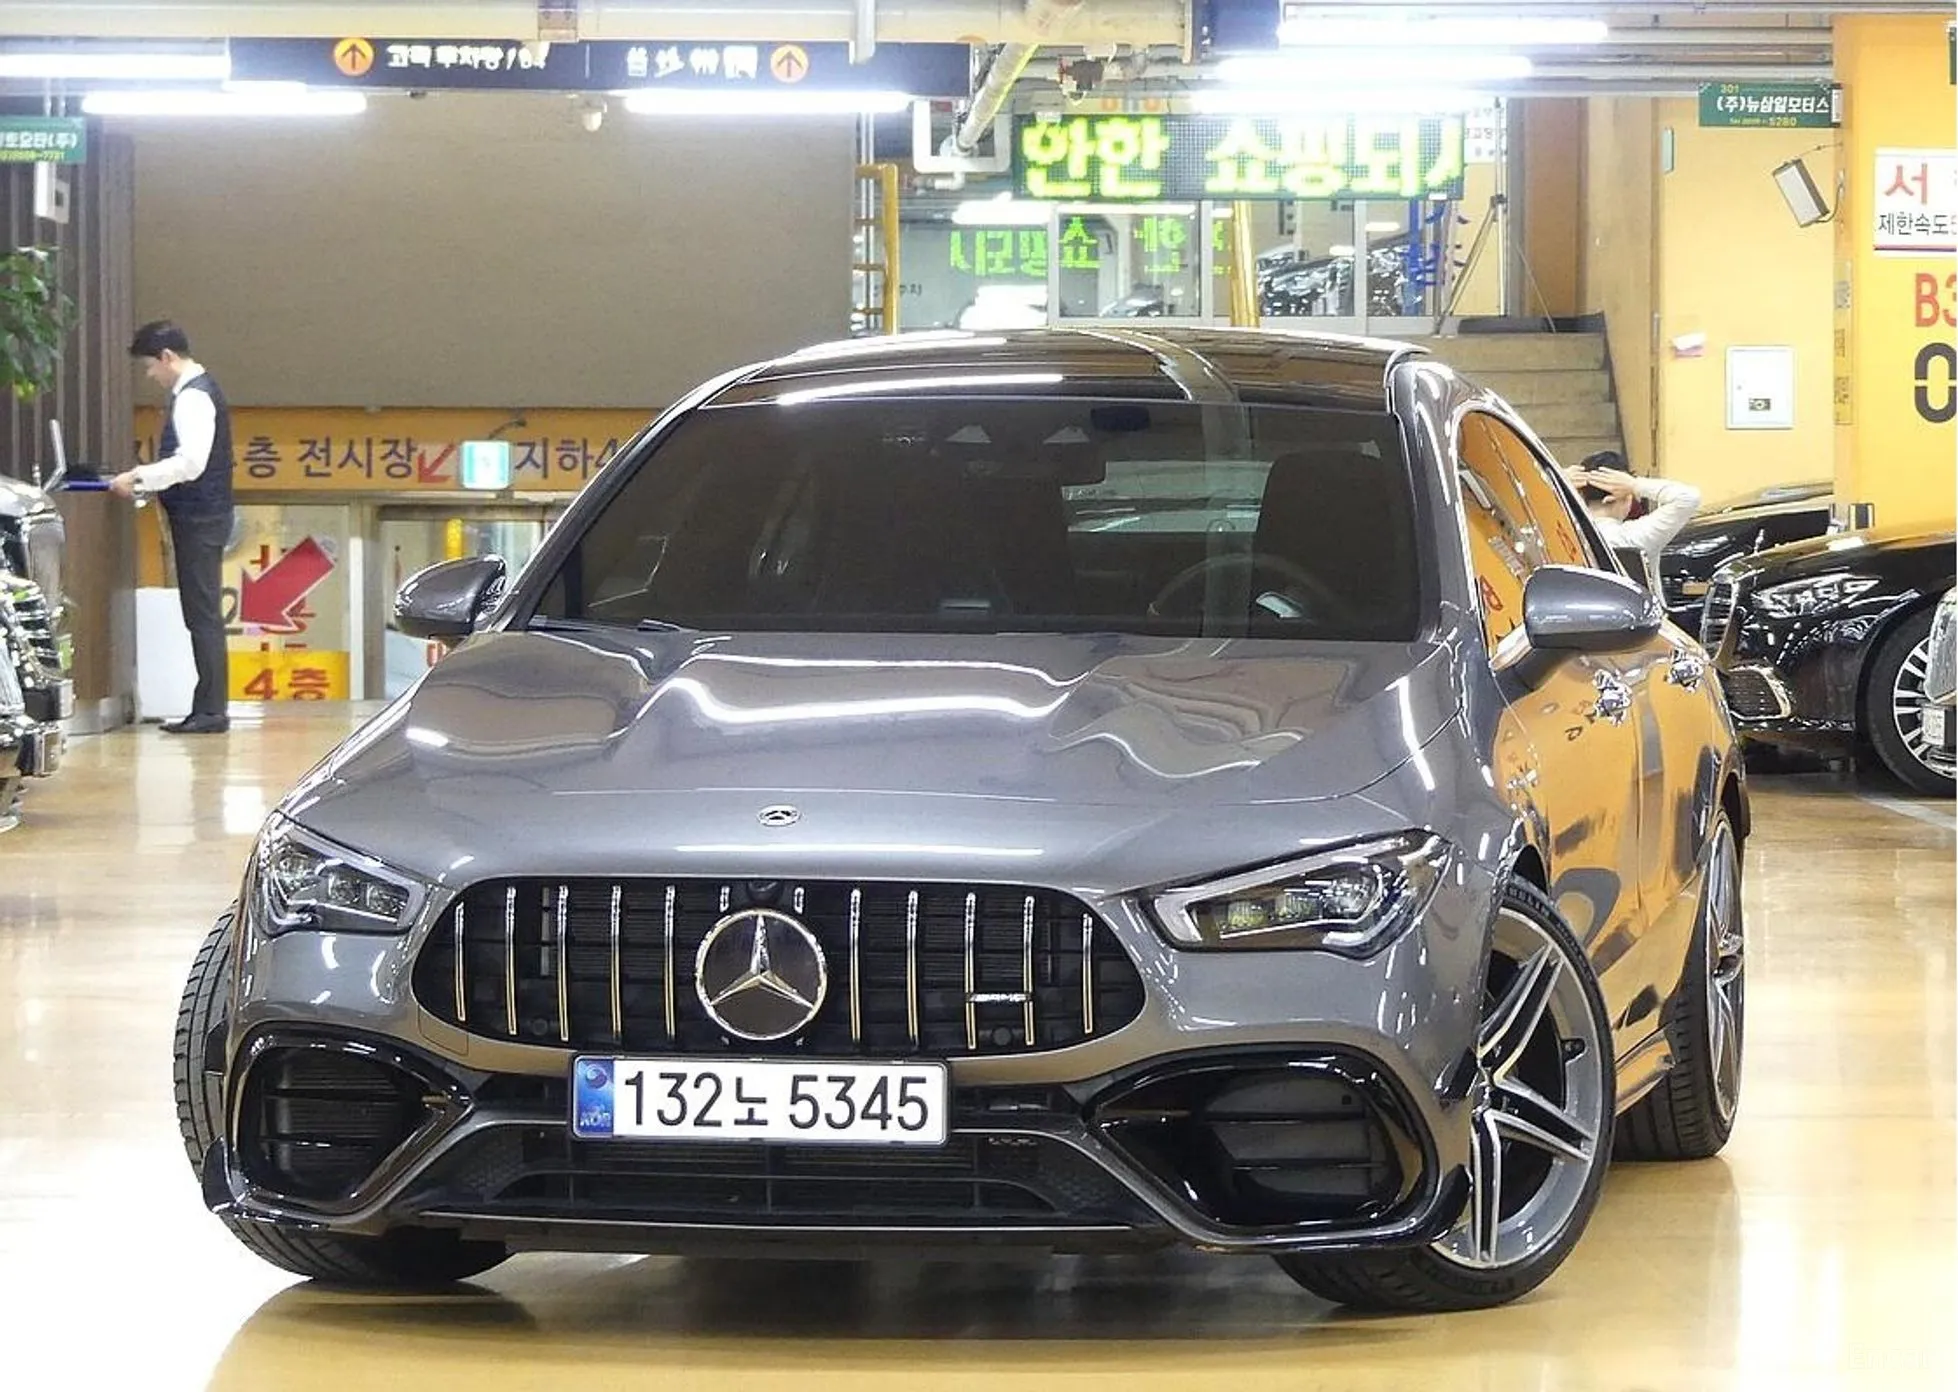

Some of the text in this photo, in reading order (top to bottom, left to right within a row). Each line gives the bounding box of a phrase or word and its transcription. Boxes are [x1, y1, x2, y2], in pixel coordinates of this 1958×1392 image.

[298, 436, 418, 479] 전시장
[624, 1070, 930, 1132] 132노 5345
